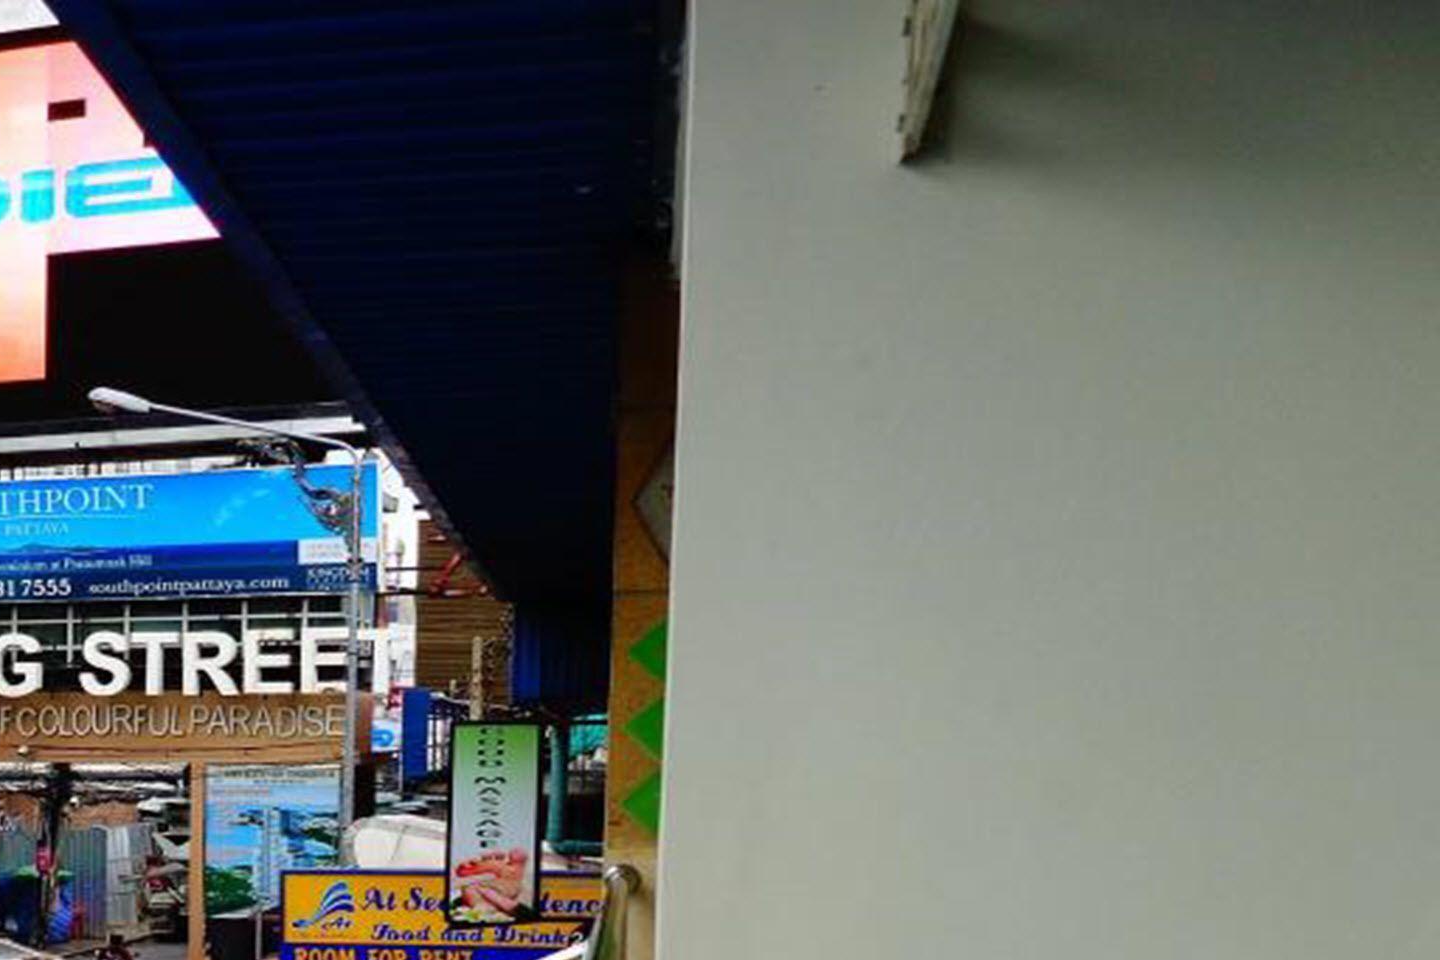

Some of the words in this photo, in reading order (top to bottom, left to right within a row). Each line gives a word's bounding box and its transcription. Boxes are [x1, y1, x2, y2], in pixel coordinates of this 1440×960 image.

[4, 521, 69, 538] PATTAYA
[20, 578, 72, 597] 7555
[89, 576, 290, 597] southpointpattaya.com
[78, 625, 406, 698] STREET
[15, 703, 182, 738] COLOURFUL
[190, 703, 346, 738] PARADISE
[370, 923, 431, 941] Food
